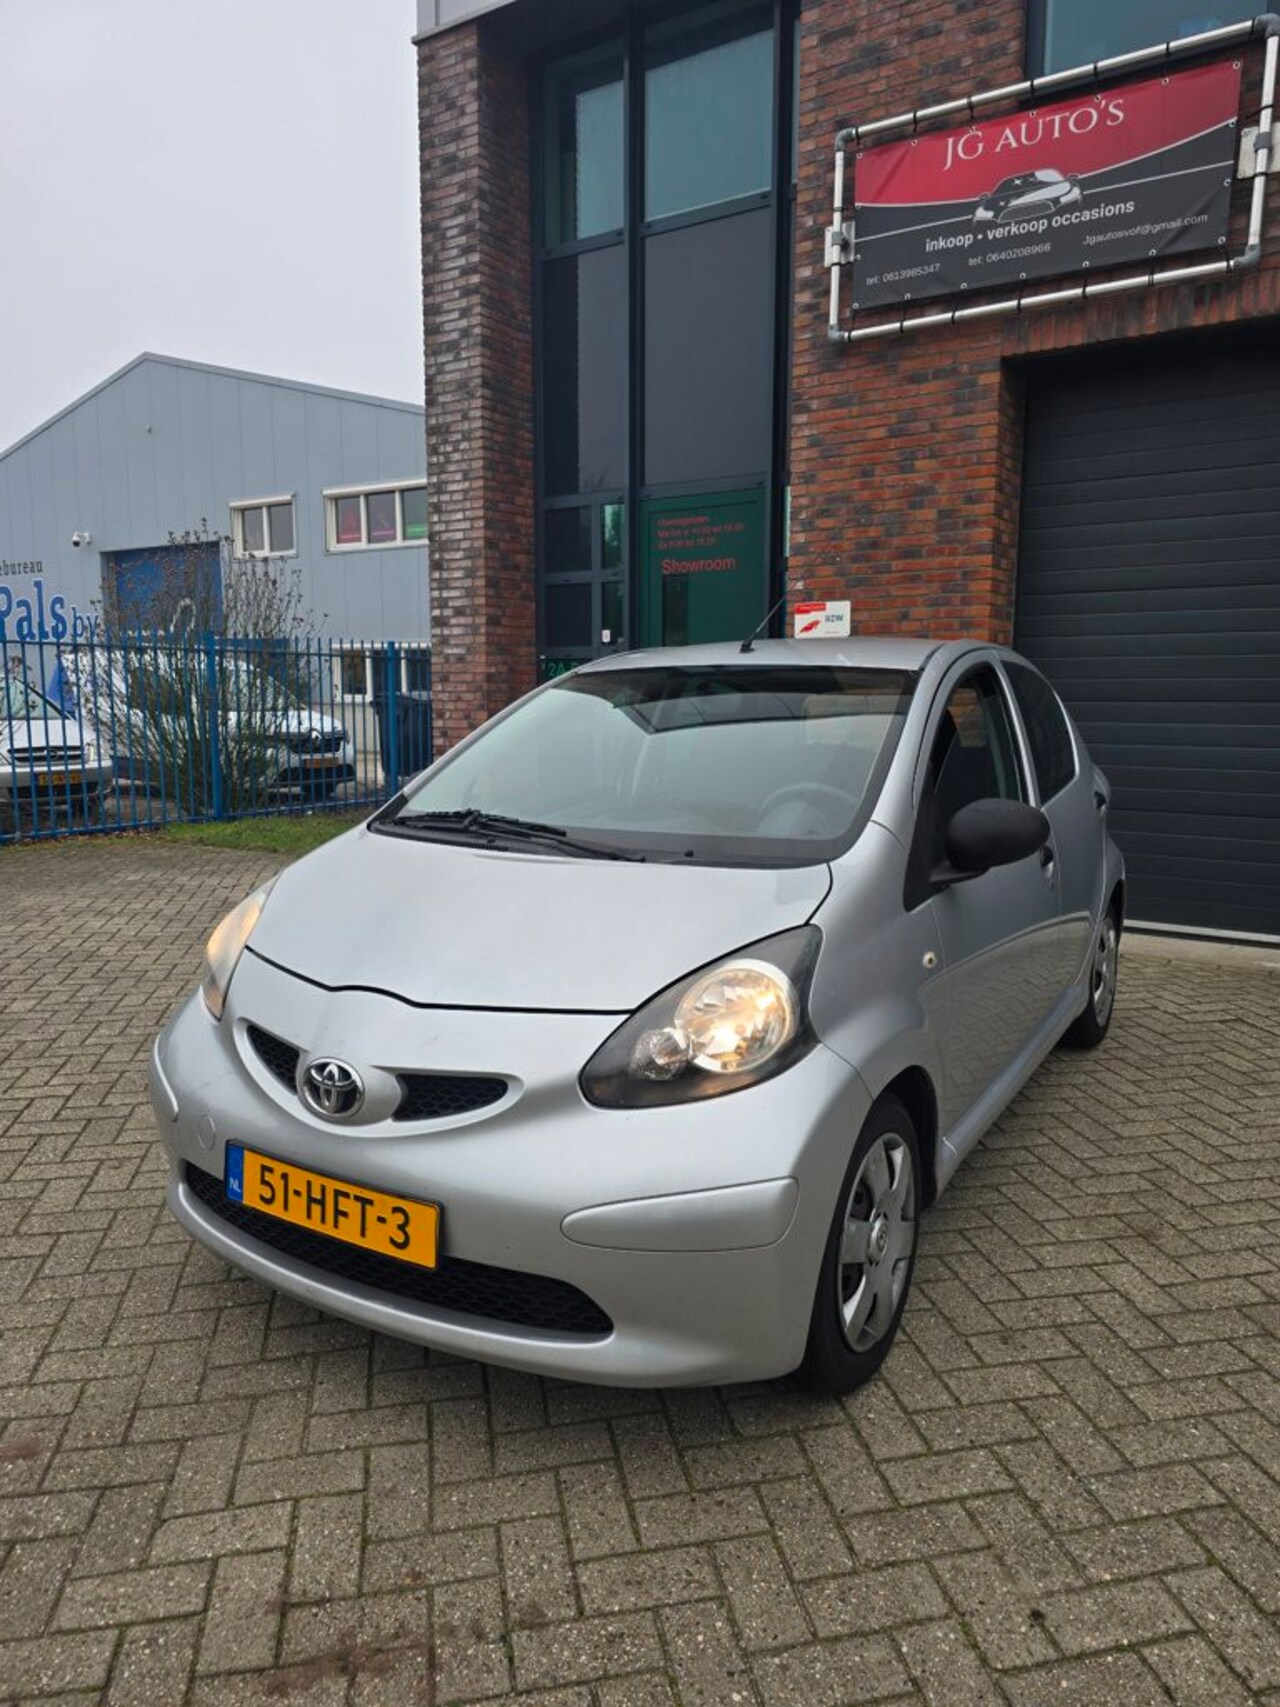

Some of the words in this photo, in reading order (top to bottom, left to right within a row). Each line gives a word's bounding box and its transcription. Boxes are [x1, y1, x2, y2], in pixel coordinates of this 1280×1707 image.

[943, 131, 984, 171] JG
[995, 99, 1125, 152] AUTO'S
[925, 230, 975, 252] inkoop
[986, 217, 1049, 241] verkoop
[1051, 201, 1135, 228] occasions
[968, 252, 985, 267] tel:
[662, 558, 736, 574] Showroom
[0, 580, 68, 640] Pals
[229, 1177, 241, 1193] NL
[258, 1163, 411, 1250] 51-HFT-3
